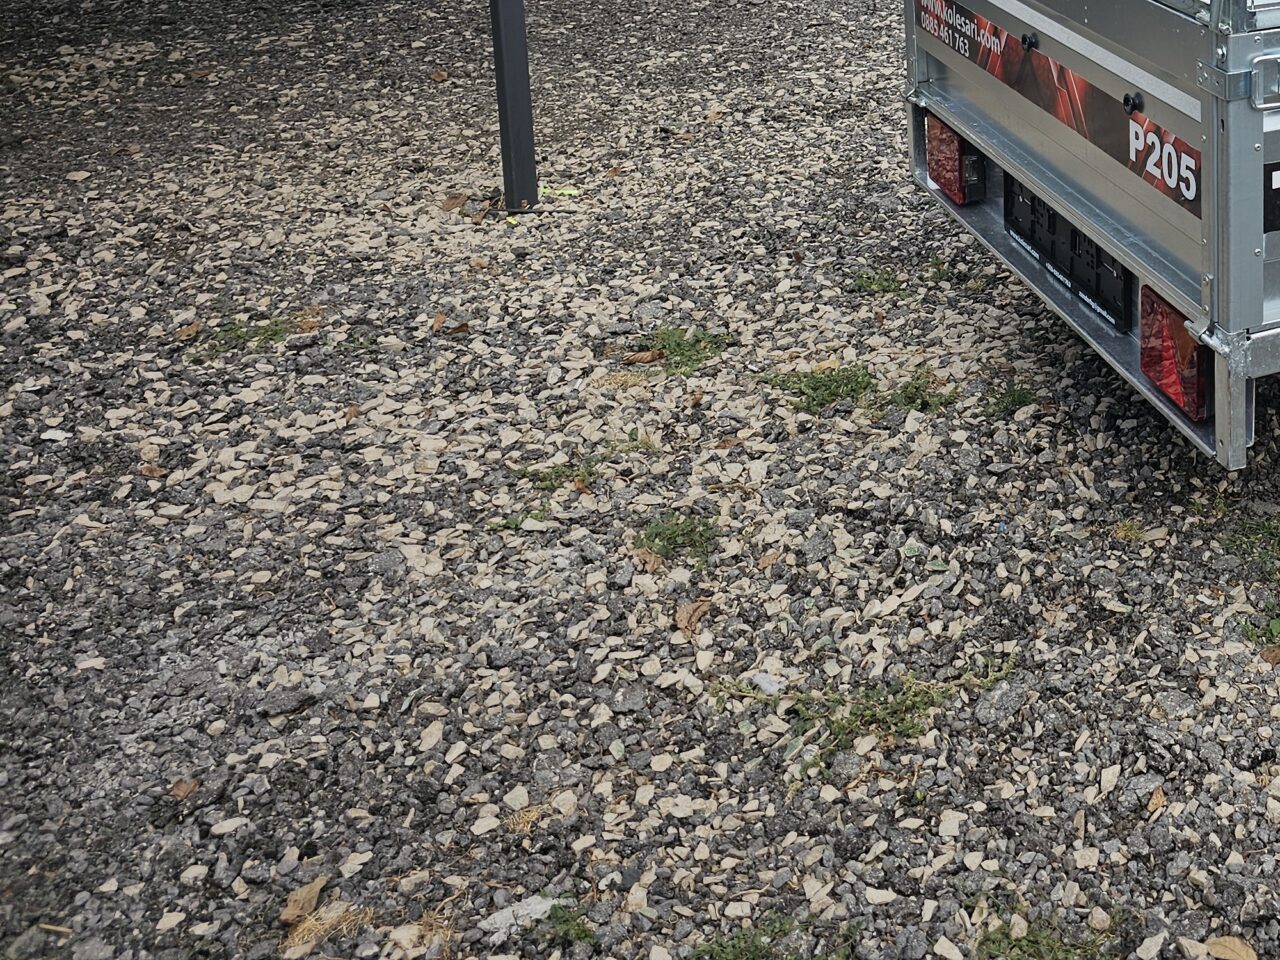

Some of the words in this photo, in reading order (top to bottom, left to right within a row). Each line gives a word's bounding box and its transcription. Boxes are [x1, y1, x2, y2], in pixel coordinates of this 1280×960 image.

[921, 11, 939, 36] 0885
[939, 24, 953, 47] 461
[954, 32, 970, 57] 763
[1128, 118, 1197, 201] P205
